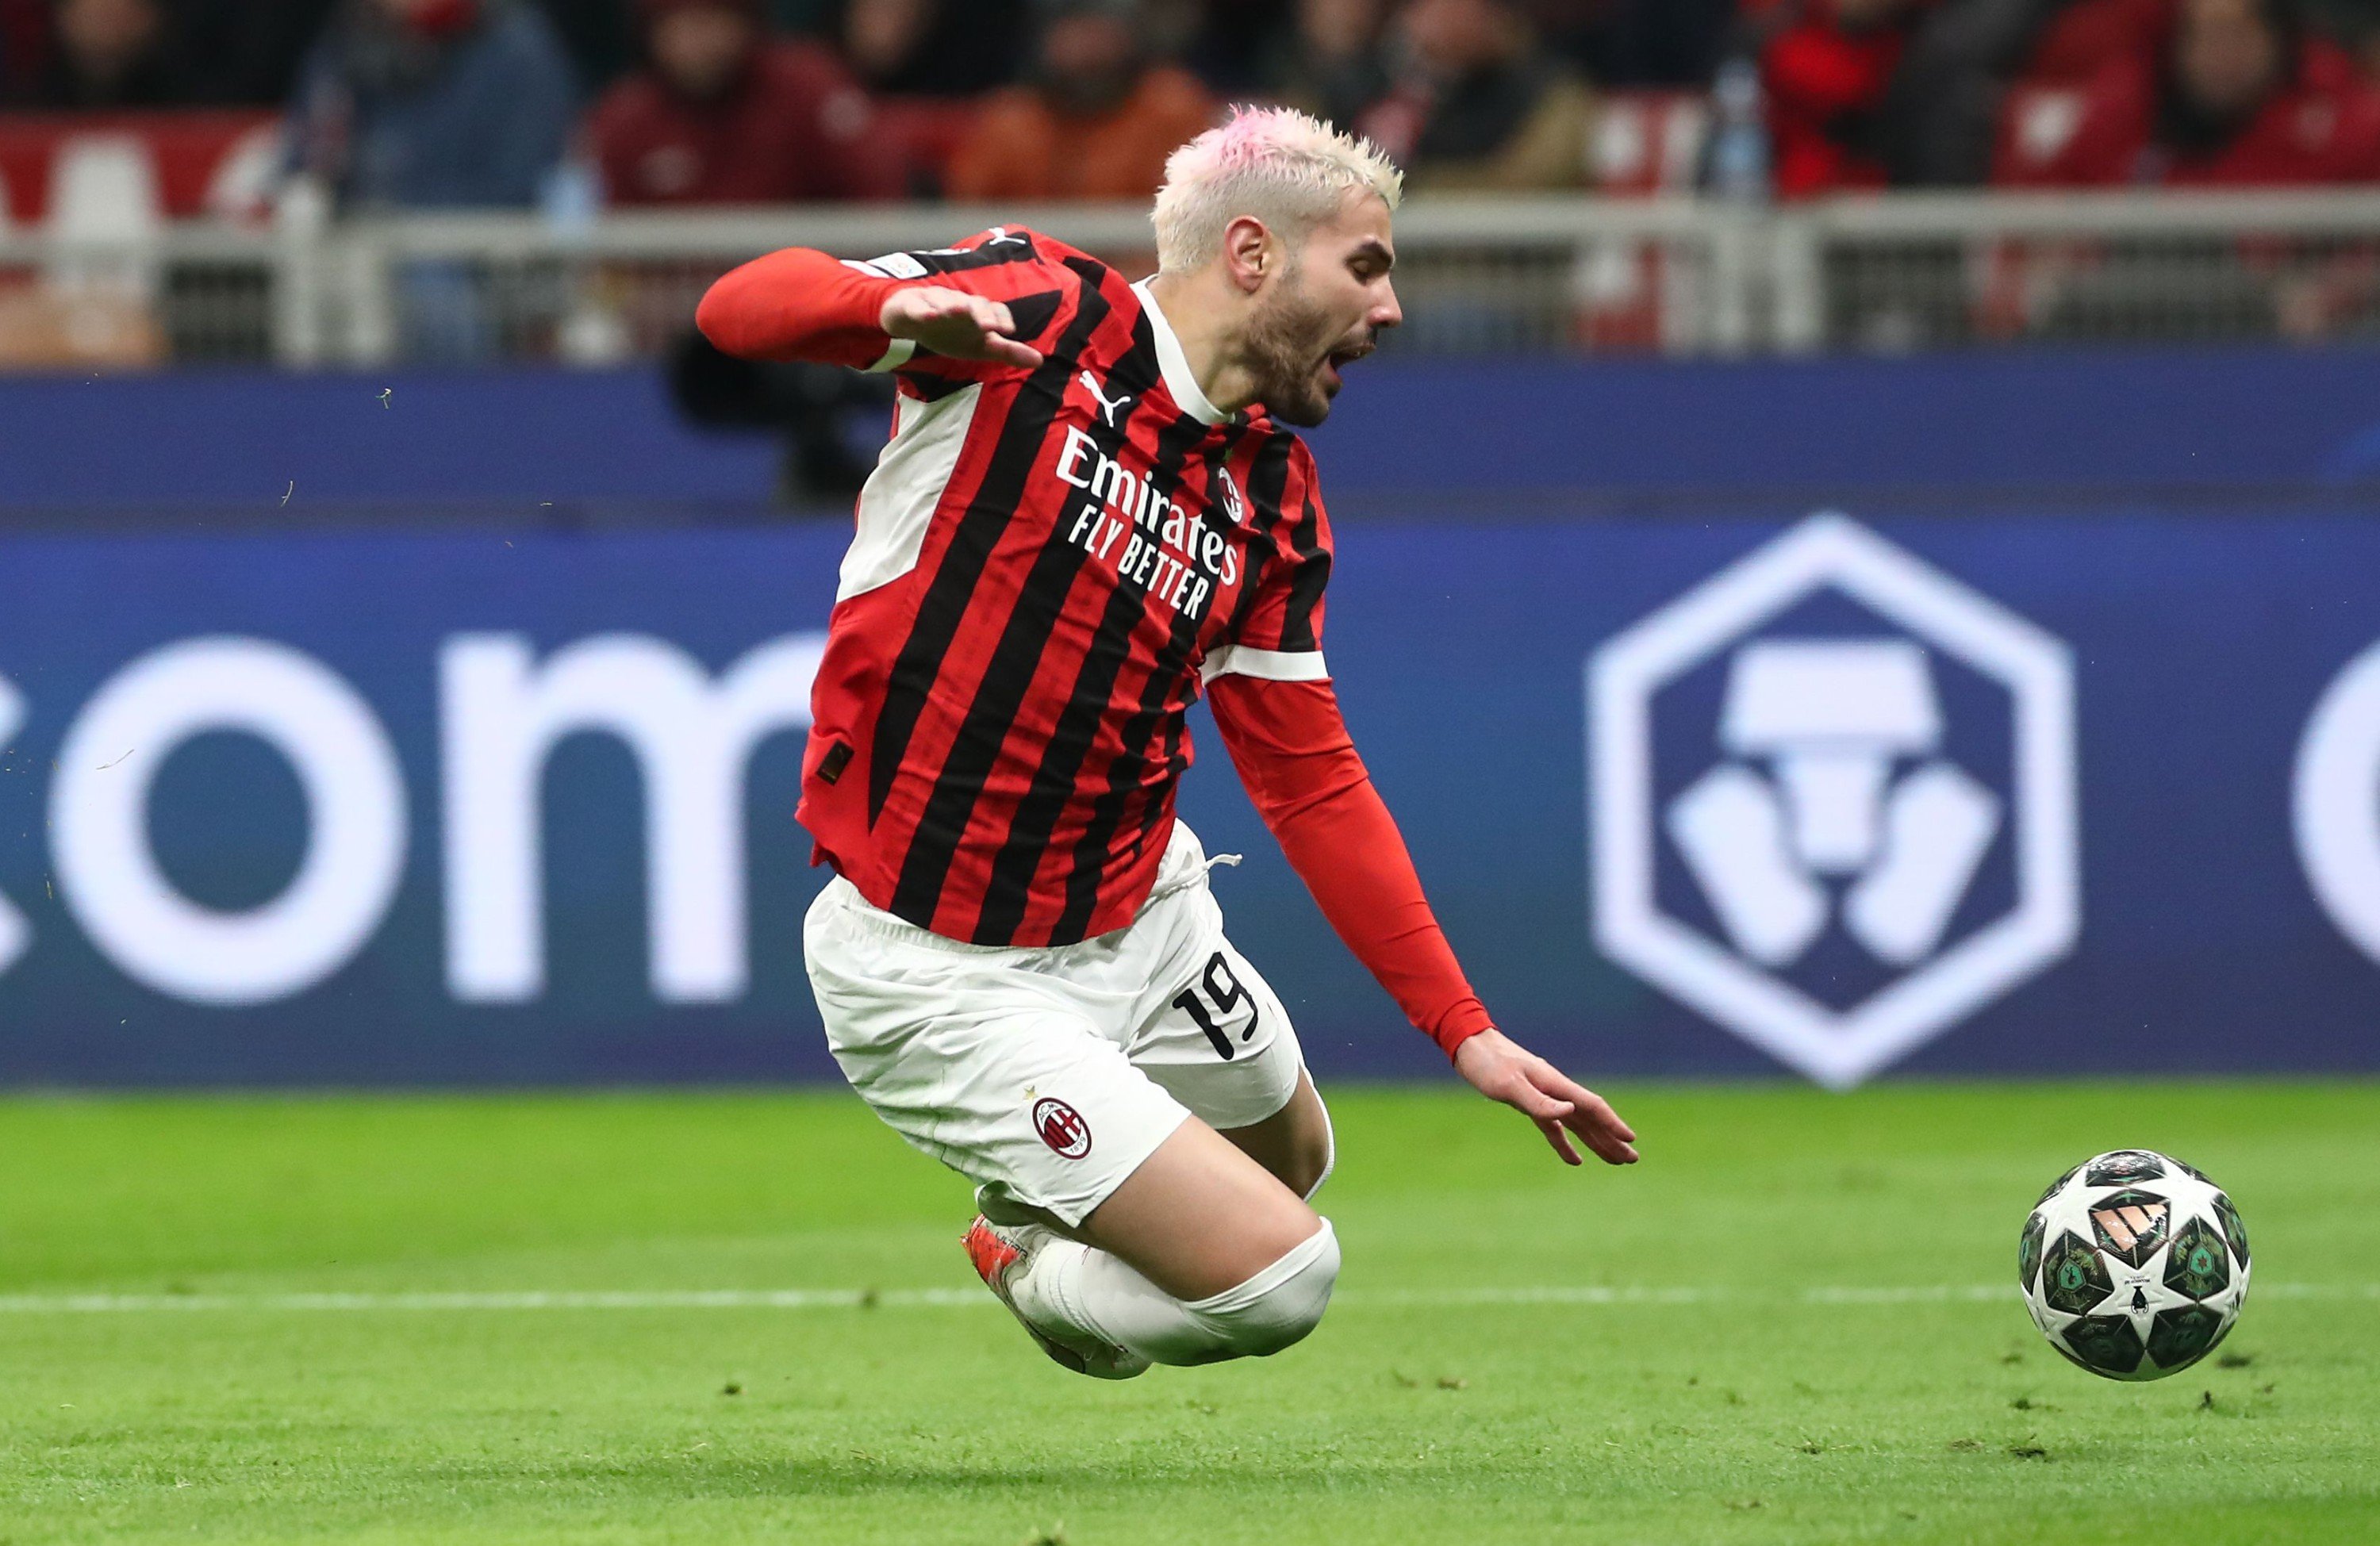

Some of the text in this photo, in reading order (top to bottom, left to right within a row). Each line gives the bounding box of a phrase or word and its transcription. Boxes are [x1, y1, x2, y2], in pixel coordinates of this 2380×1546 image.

[1056, 424, 1237, 585] Emirates
[1068, 504, 1209, 620] FLY BETTER
[0, 636, 828, 1003] om
[1173, 951, 1258, 1060] 19
[1038, 1103, 1058, 1125] ACM
[1069, 1136, 1086, 1153] 1899
